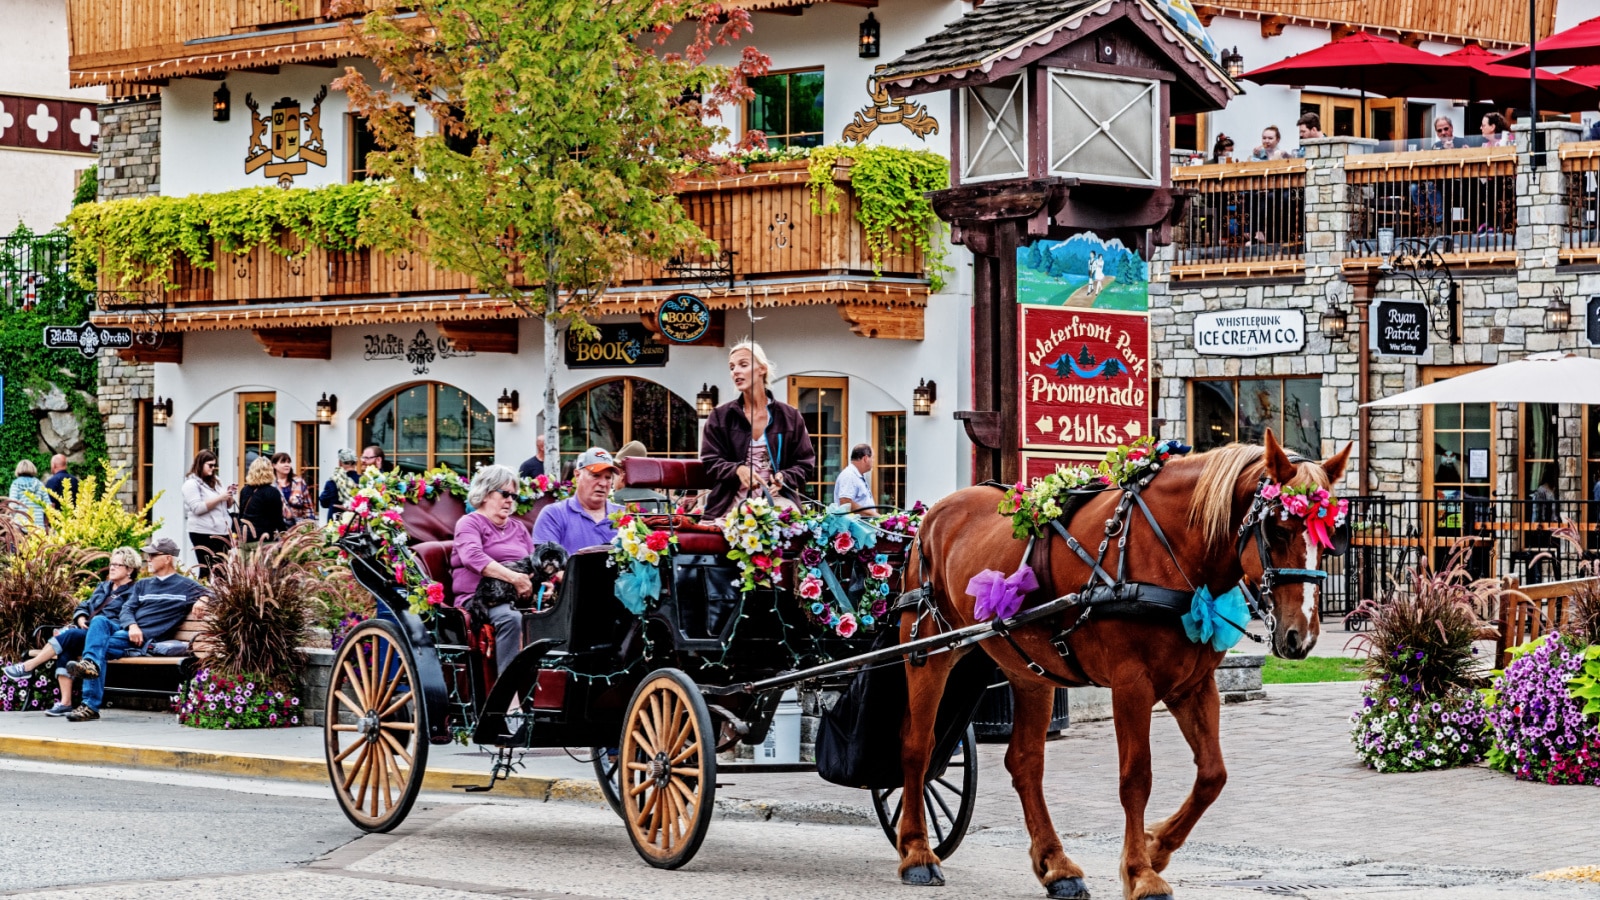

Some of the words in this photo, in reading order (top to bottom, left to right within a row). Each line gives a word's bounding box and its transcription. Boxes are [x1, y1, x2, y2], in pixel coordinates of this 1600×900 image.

[667, 312, 705, 326] BOOK
[1216, 315, 1281, 328] WHISTLEPUNK
[1388, 308, 1416, 328] Ryan
[50, 329, 78, 345] Black
[100, 330, 130, 345] Orchid
[1199, 330, 1219, 346] ICE
[1222, 329, 1271, 345] CREAM
[1275, 328, 1299, 344] CO.
[1384, 324, 1421, 341] Patrick
[363, 334, 405, 356] Black
[576, 341, 637, 364] BOOK
[1028, 315, 1112, 366] Waterfront
[1115, 330, 1147, 377] Park
[1028, 373, 1145, 407] Promenade
